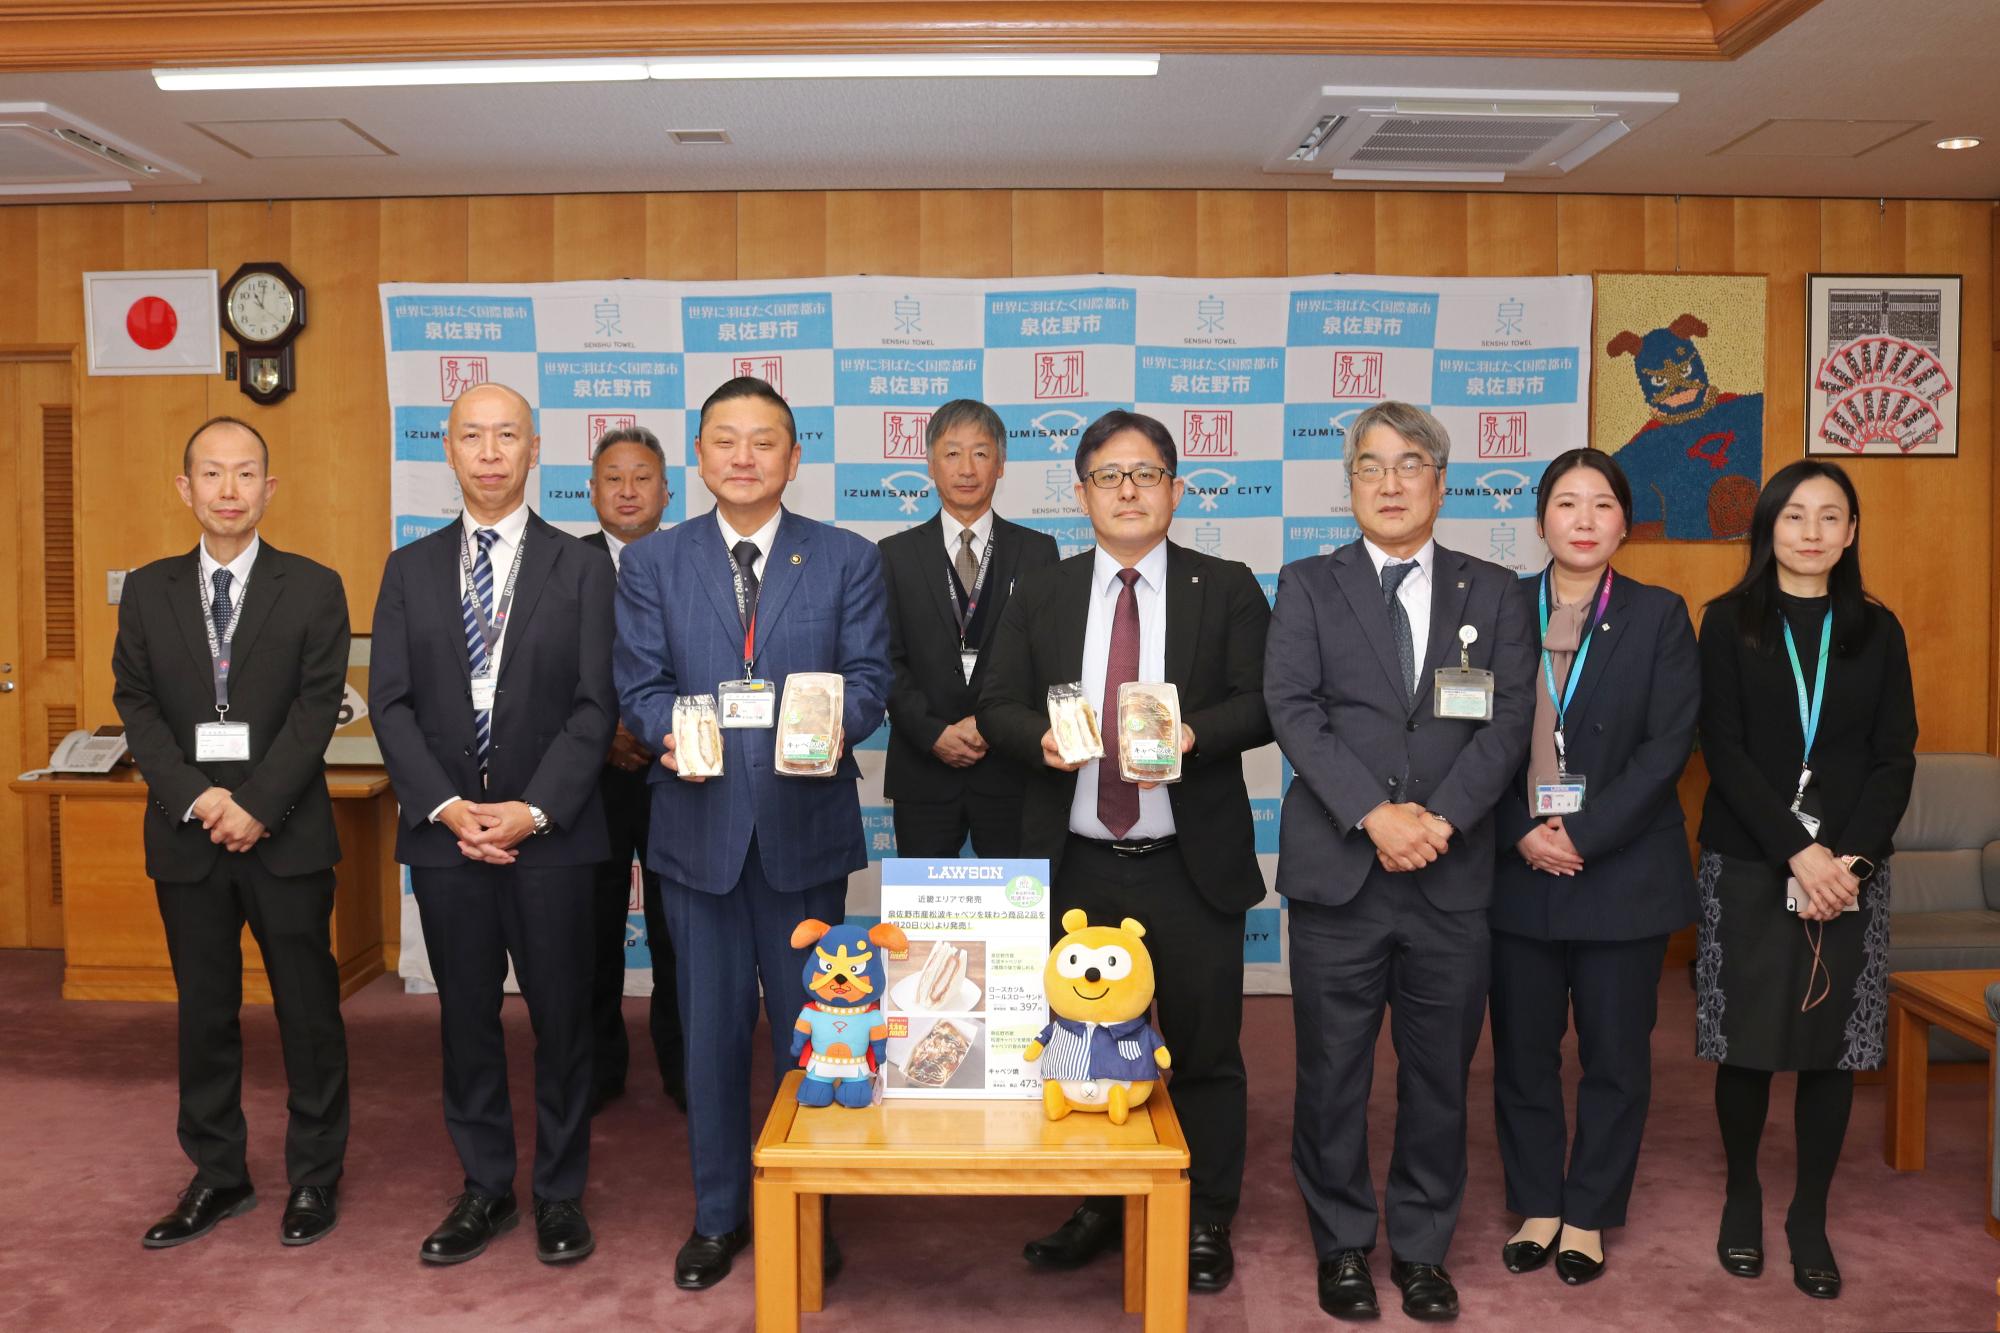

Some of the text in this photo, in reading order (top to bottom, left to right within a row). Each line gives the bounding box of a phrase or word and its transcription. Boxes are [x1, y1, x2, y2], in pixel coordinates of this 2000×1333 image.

[396, 305, 528, 318] 世界に羽ばたく国際都市
[688, 302, 825, 318] 世界に羽ばたく国際都市
[992, 298, 1129, 314] 世界に羽ばたく国際都市
[1296, 300, 1432, 315] 世界に羽ばたく国際都市
[426, 322, 502, 340] 泉佐野市
[718, 320, 798, 340] 泉佐野市
[1020, 315, 1102, 336] 泉佐野市
[1323, 316, 1402, 335] 泉佐野市
[544, 362, 678, 376] 世界に羽ばたく国際都市
[840, 358, 976, 373] 世界に羽ばたく国際都市
[1142, 356, 1278, 370] 世界に羽ばたく国際都市
[1440, 357, 1572, 372] 世界に羽ばたく国際都市
[574, 379, 652, 398] 泉佐野市
[870, 376, 950, 396] 泉佐野市
[1170, 375, 1250, 394] 泉佐野市
[1466, 376, 1544, 396] 泉佐野市
[800, 432, 823, 440] ITY
[1009, 428, 1079, 438] UMISANO
[1292, 428, 1344, 436] IZUMIS
[844, 490, 928, 498] IZUMISANO
[1185, 486, 1272, 495] SANO CITY
[1445, 488, 1523, 496] ZUMISANO
[976, 545, 994, 590] IZUMISANO CITY
[505, 559, 520, 597] IZUMISANO
[733, 575, 742, 593] EXPO
[469, 590, 480, 608] 2025
[206, 620, 215, 638] EXPO
[209, 638, 219, 657] 2025
[928, 866, 1003, 880] LAWSON
[918, 895, 982, 904] 近畿エリアで発売
[888, 910, 1046, 919] 泉佐野市産松波キャベツを味わう商品2品を
[1246, 933, 1269, 941] ITY
